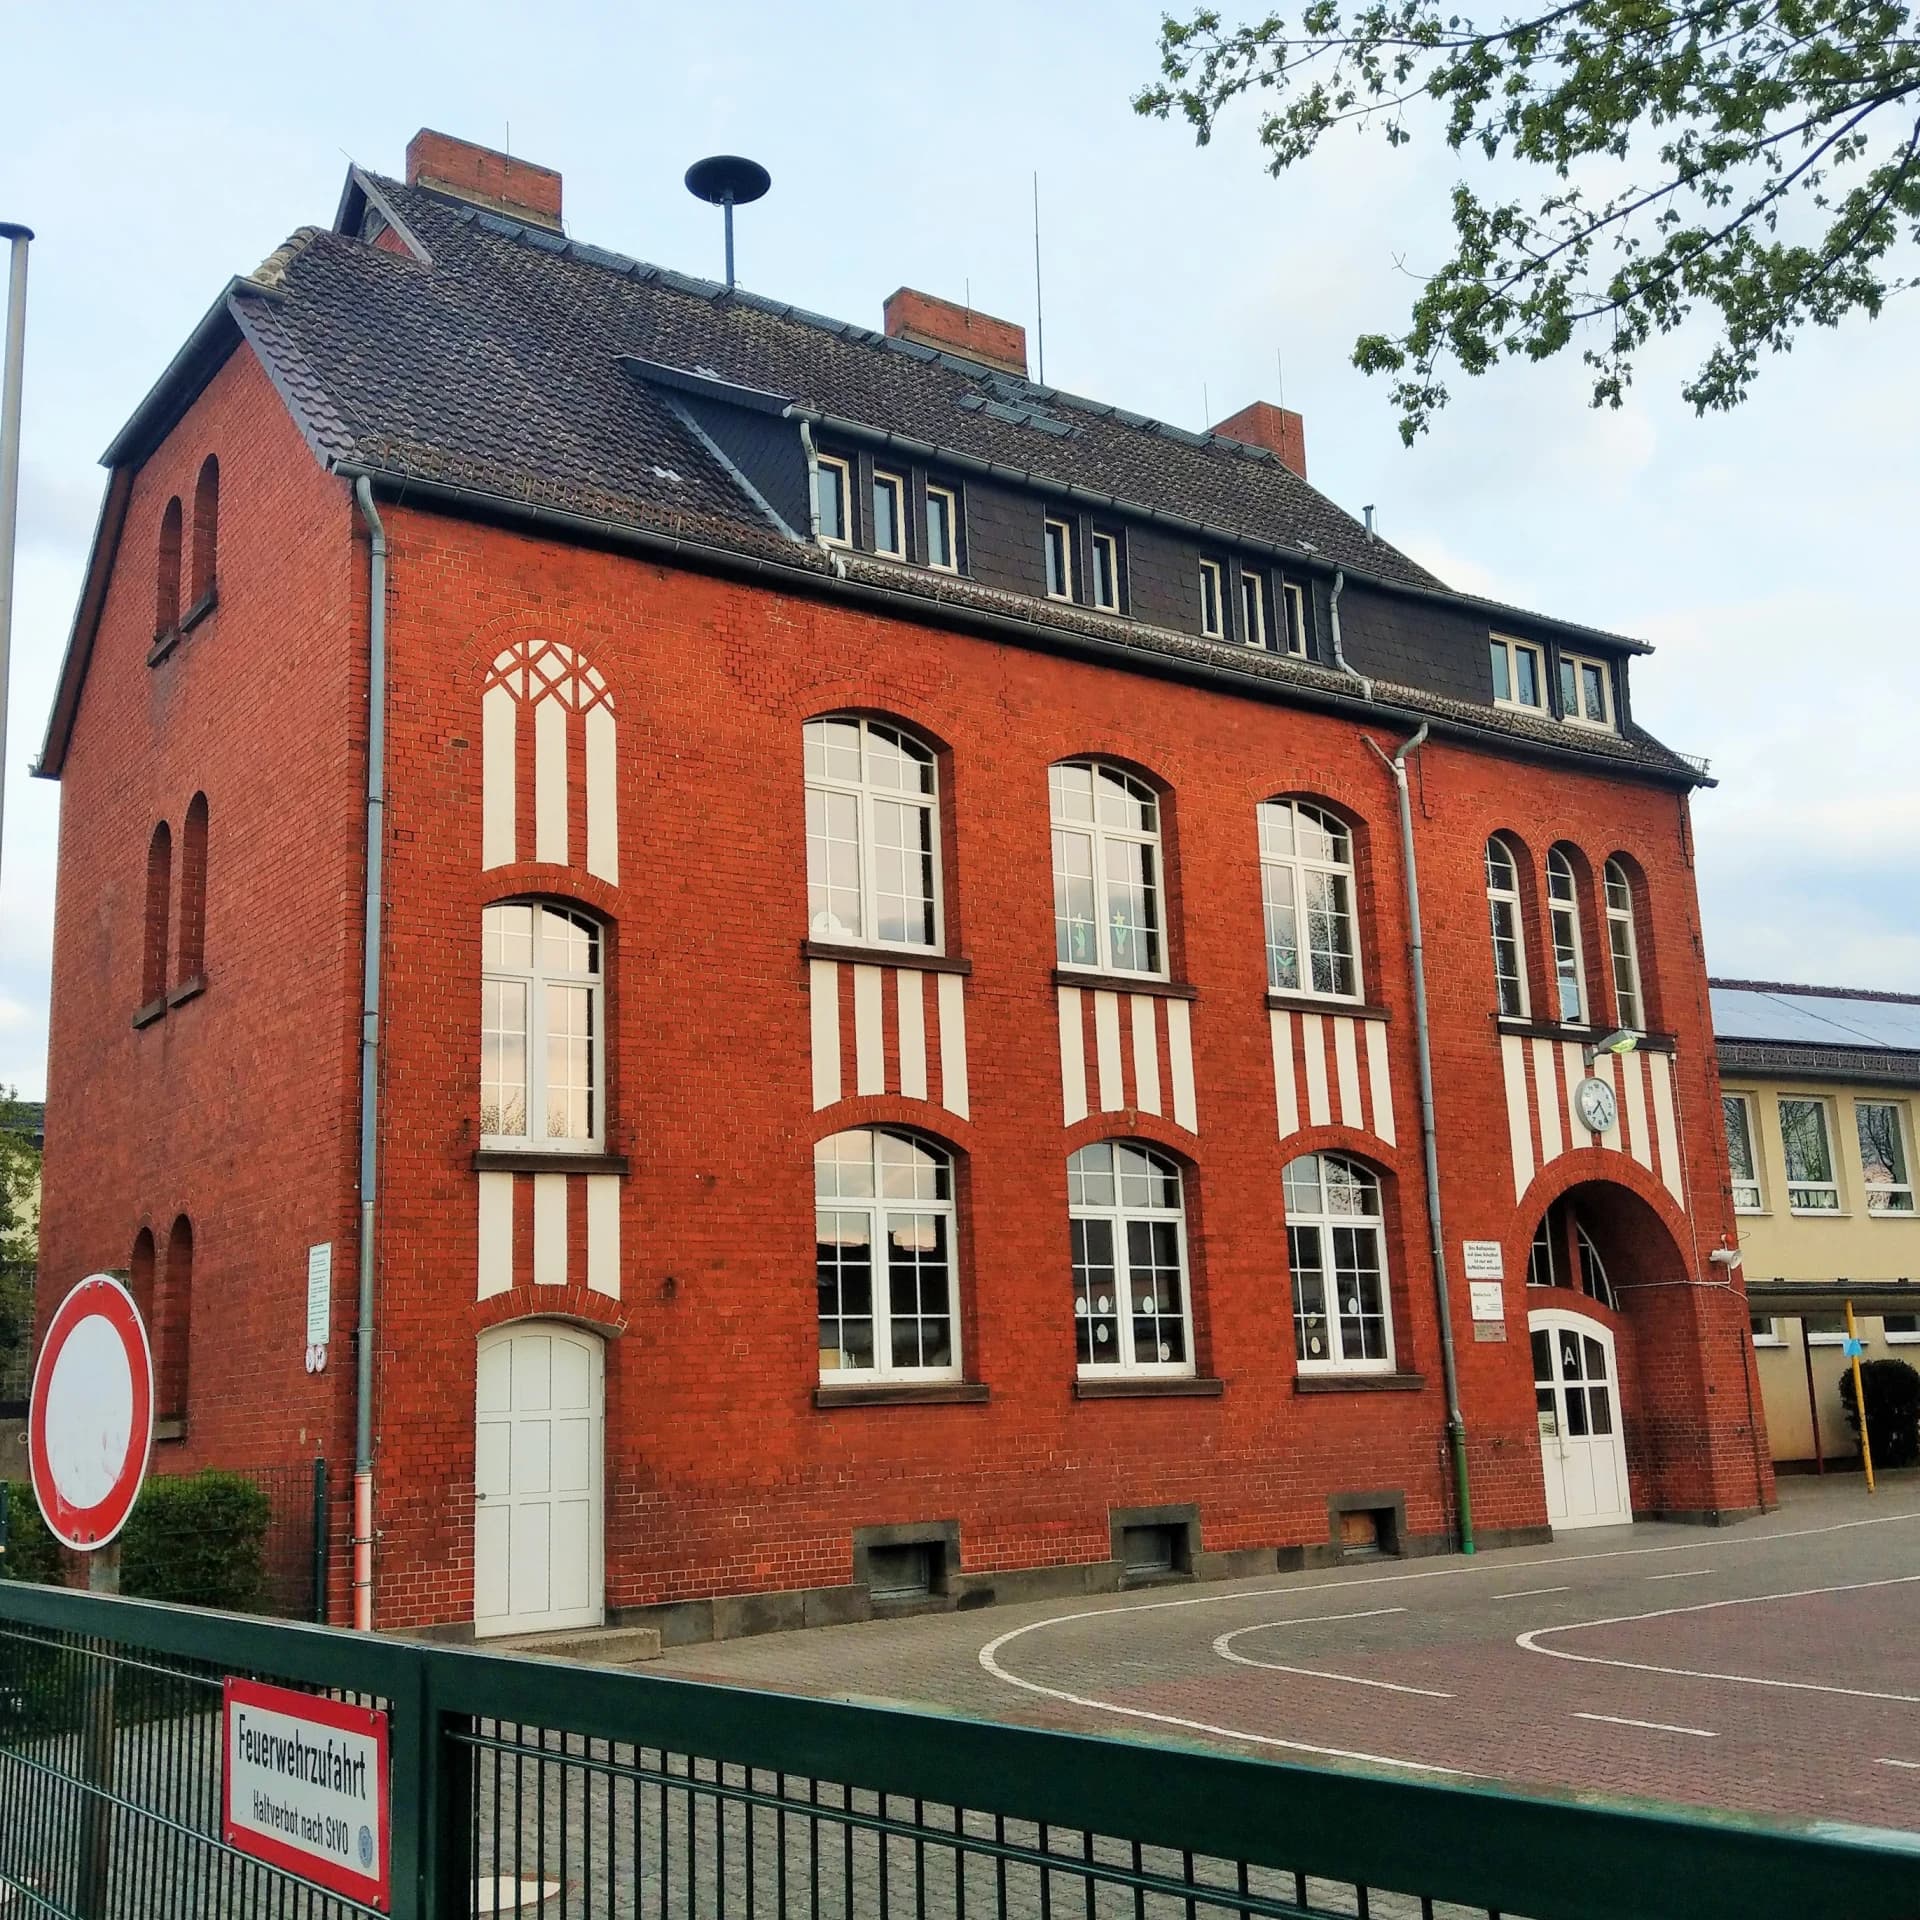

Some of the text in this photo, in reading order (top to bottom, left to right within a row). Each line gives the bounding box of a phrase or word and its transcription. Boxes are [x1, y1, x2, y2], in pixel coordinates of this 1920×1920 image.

[1564, 1346, 1576, 1365] A
[239, 1714, 366, 1800] Feuerwehrzufahrt
[253, 1789, 299, 1835] Haltverbot
[301, 1812, 323, 1845] nach
[326, 1815, 348, 1855] StVO
